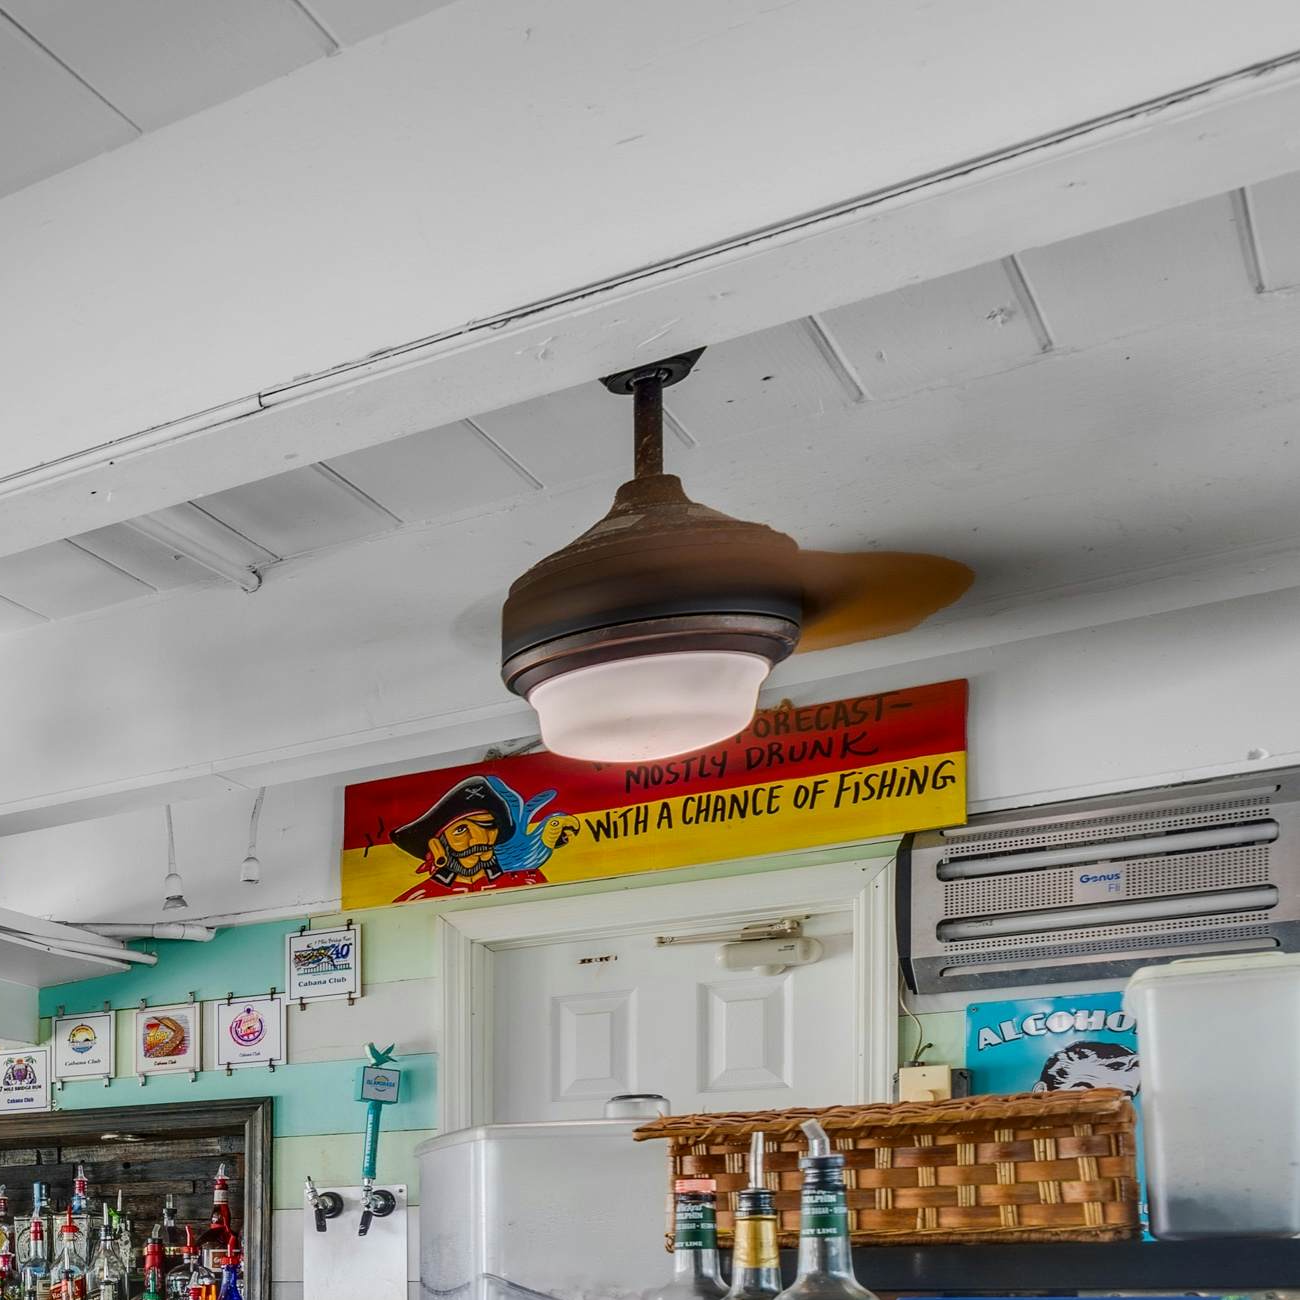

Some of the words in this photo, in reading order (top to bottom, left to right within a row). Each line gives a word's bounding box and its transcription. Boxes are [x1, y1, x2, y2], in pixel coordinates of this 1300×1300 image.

[626, 751, 727, 793] MOSTLY
[746, 732, 878, 770] DRUNK
[657, 802, 672, 830] A
[682, 785, 783, 826] CHANCE
[793, 784, 824, 809] OF
[298, 978, 327, 988] Cabana
[328, 976, 347, 985] Club
[978, 1010, 1140, 1050] ALCOHO
